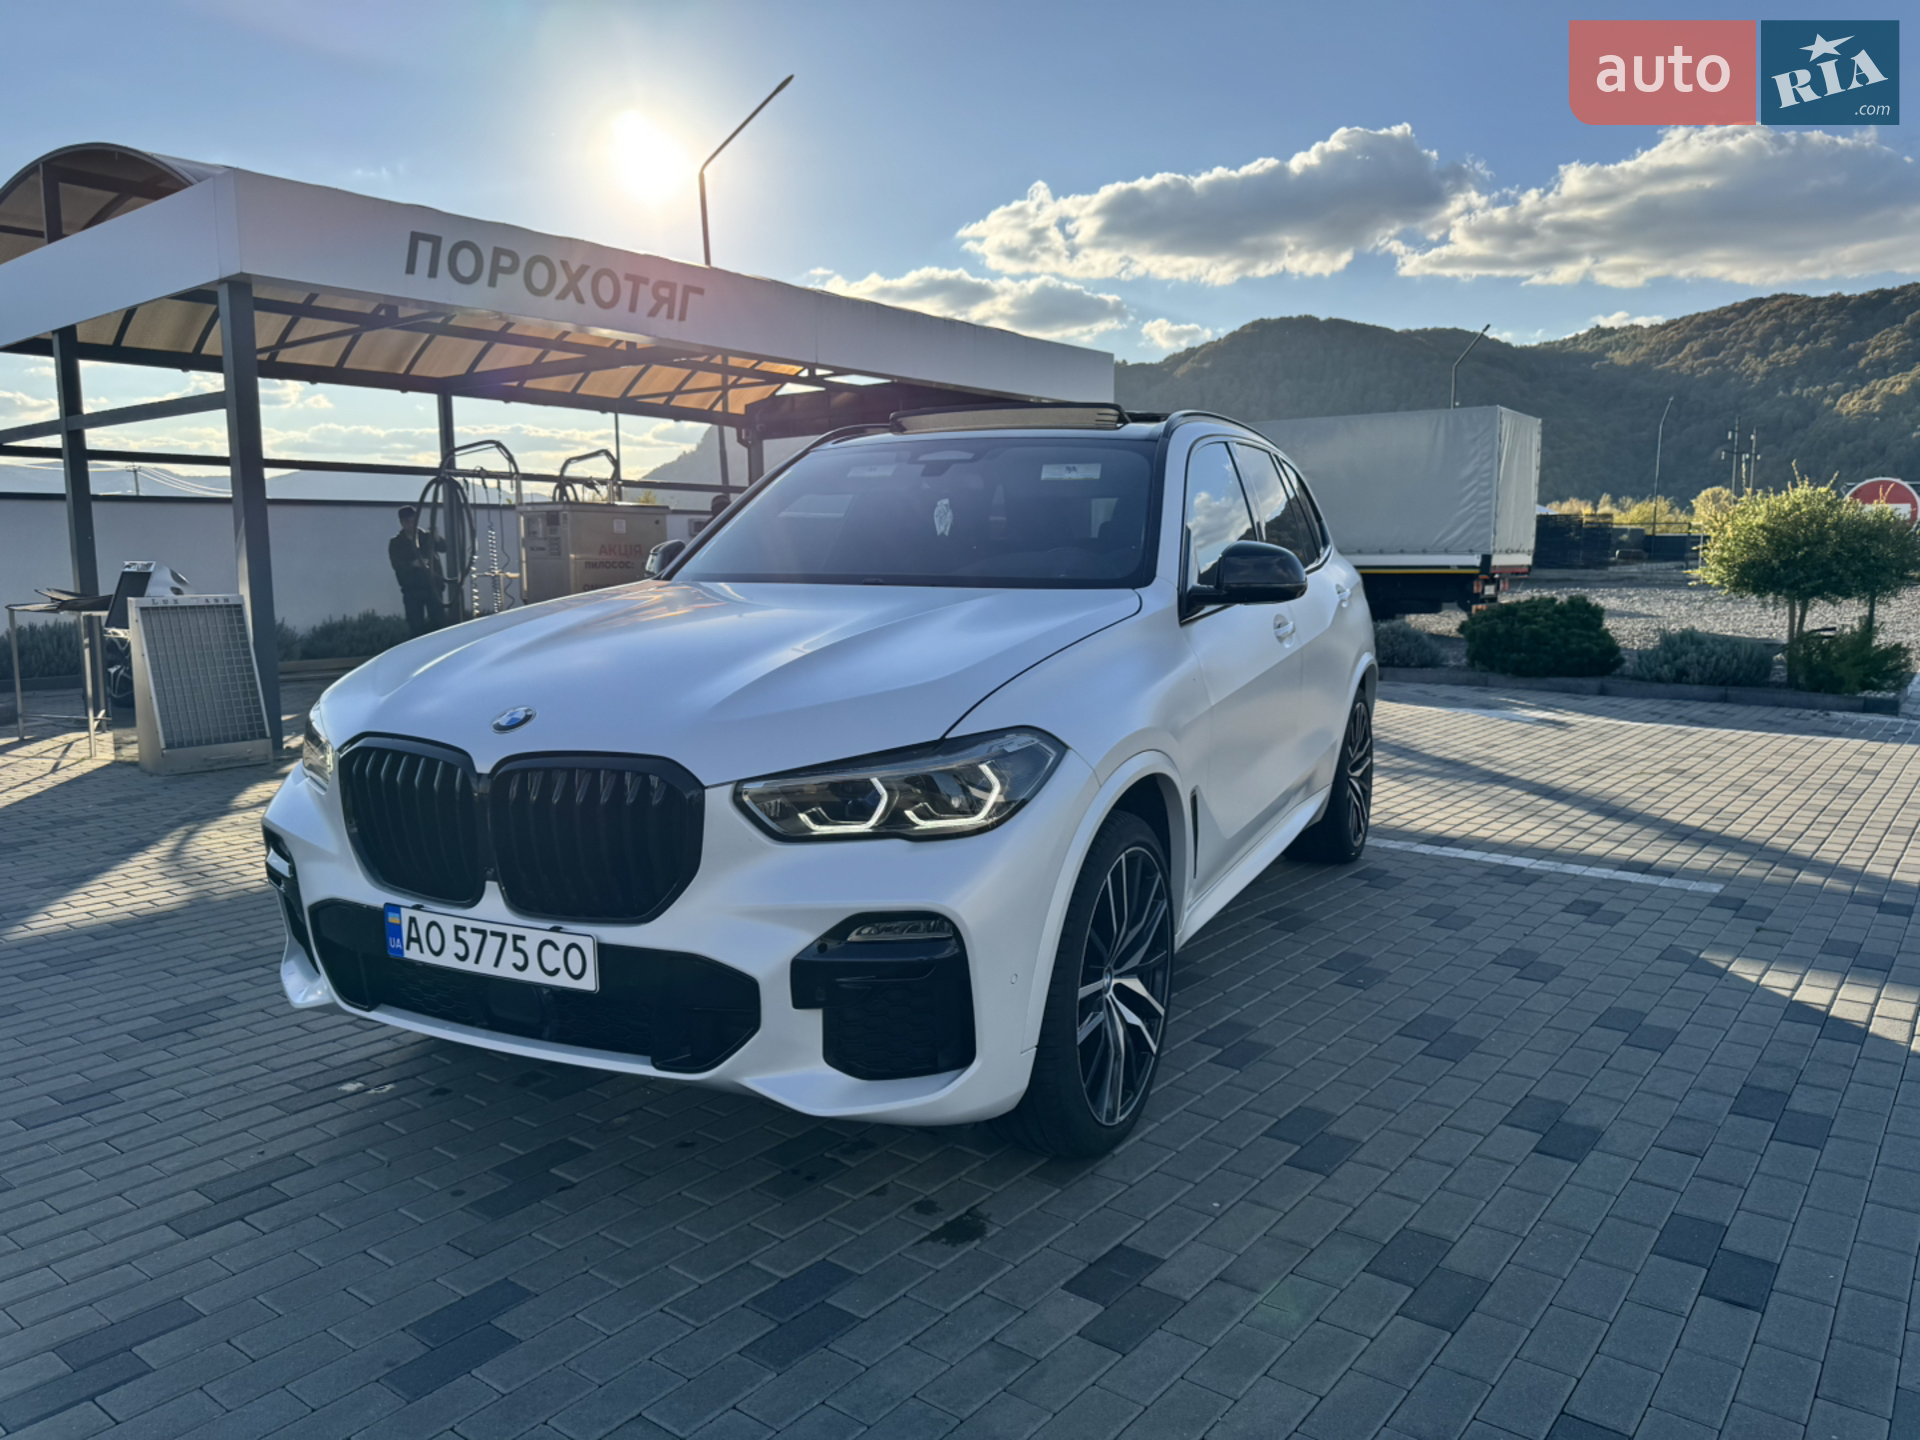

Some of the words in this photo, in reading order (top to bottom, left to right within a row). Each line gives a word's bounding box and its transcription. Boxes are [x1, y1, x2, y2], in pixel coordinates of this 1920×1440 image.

[405, 230, 705, 322] ПОРОХОТЯГ
[388, 936, 403, 949] UA
[405, 915, 446, 957] AO
[453, 924, 530, 973] 5775
[536, 938, 588, 981] CO
